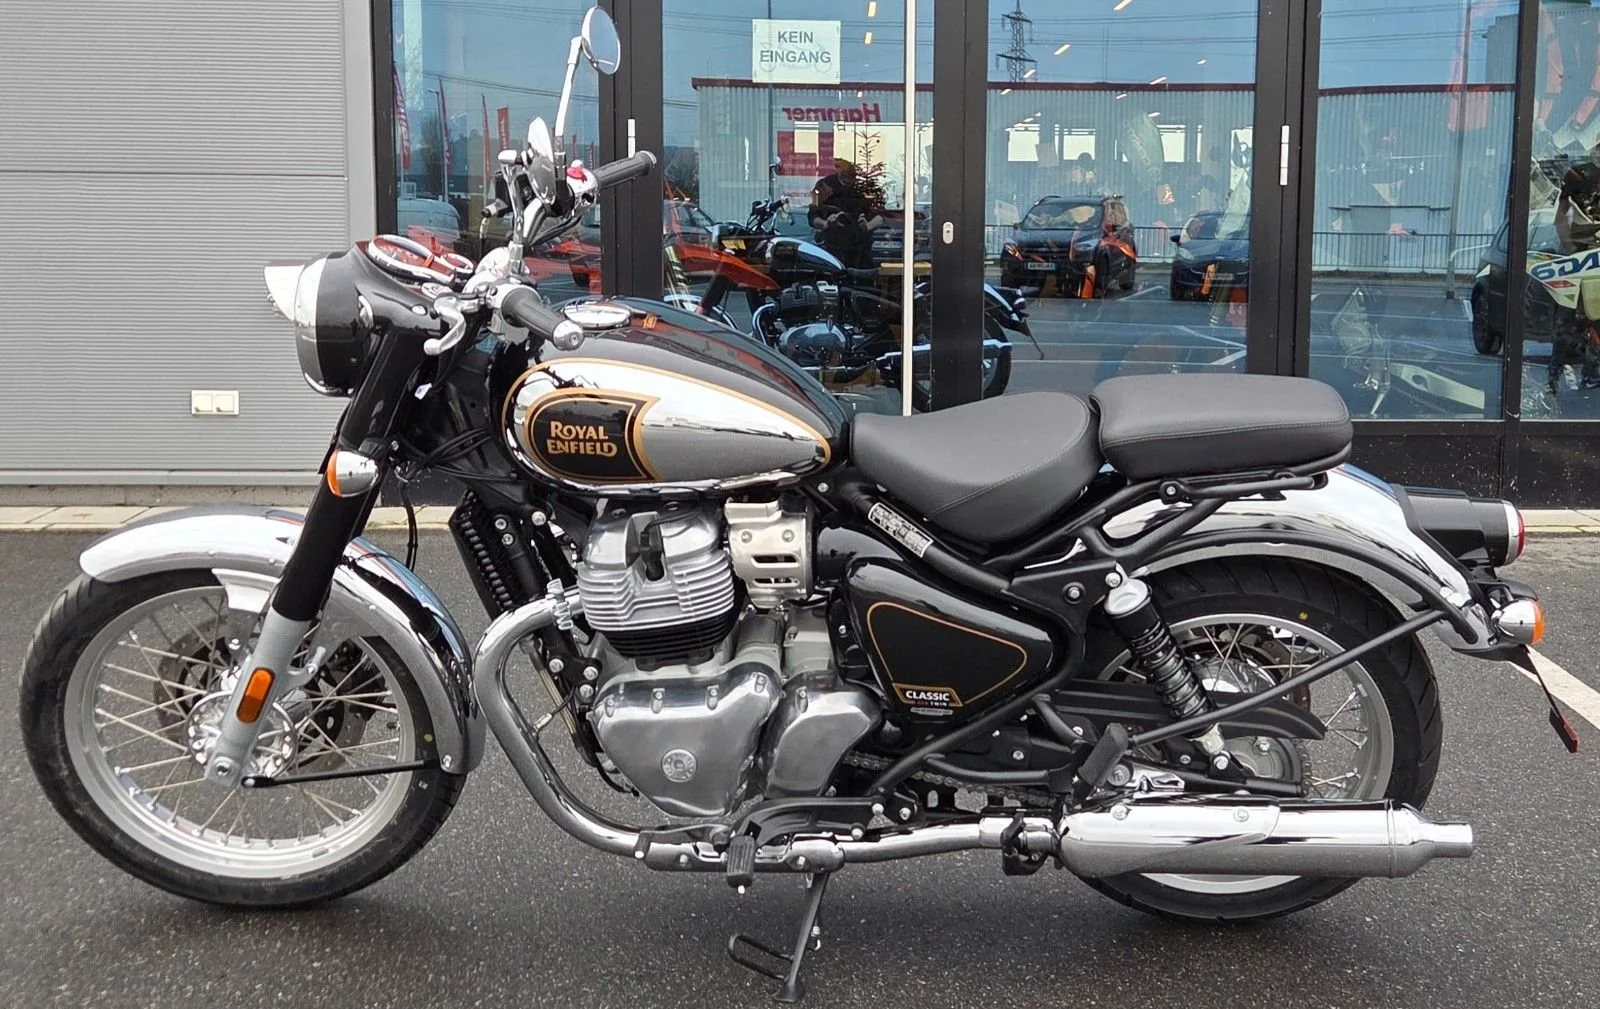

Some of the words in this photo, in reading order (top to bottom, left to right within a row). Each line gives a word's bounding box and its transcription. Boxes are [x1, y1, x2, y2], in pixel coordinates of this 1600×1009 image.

[777, 31, 813, 43] KEIN
[760, 50, 832, 63] EINGANG
[549, 421, 609, 440] ROYAL
[547, 439, 618, 457] ENFIELD
[905, 690, 950, 701] CLASSIC
